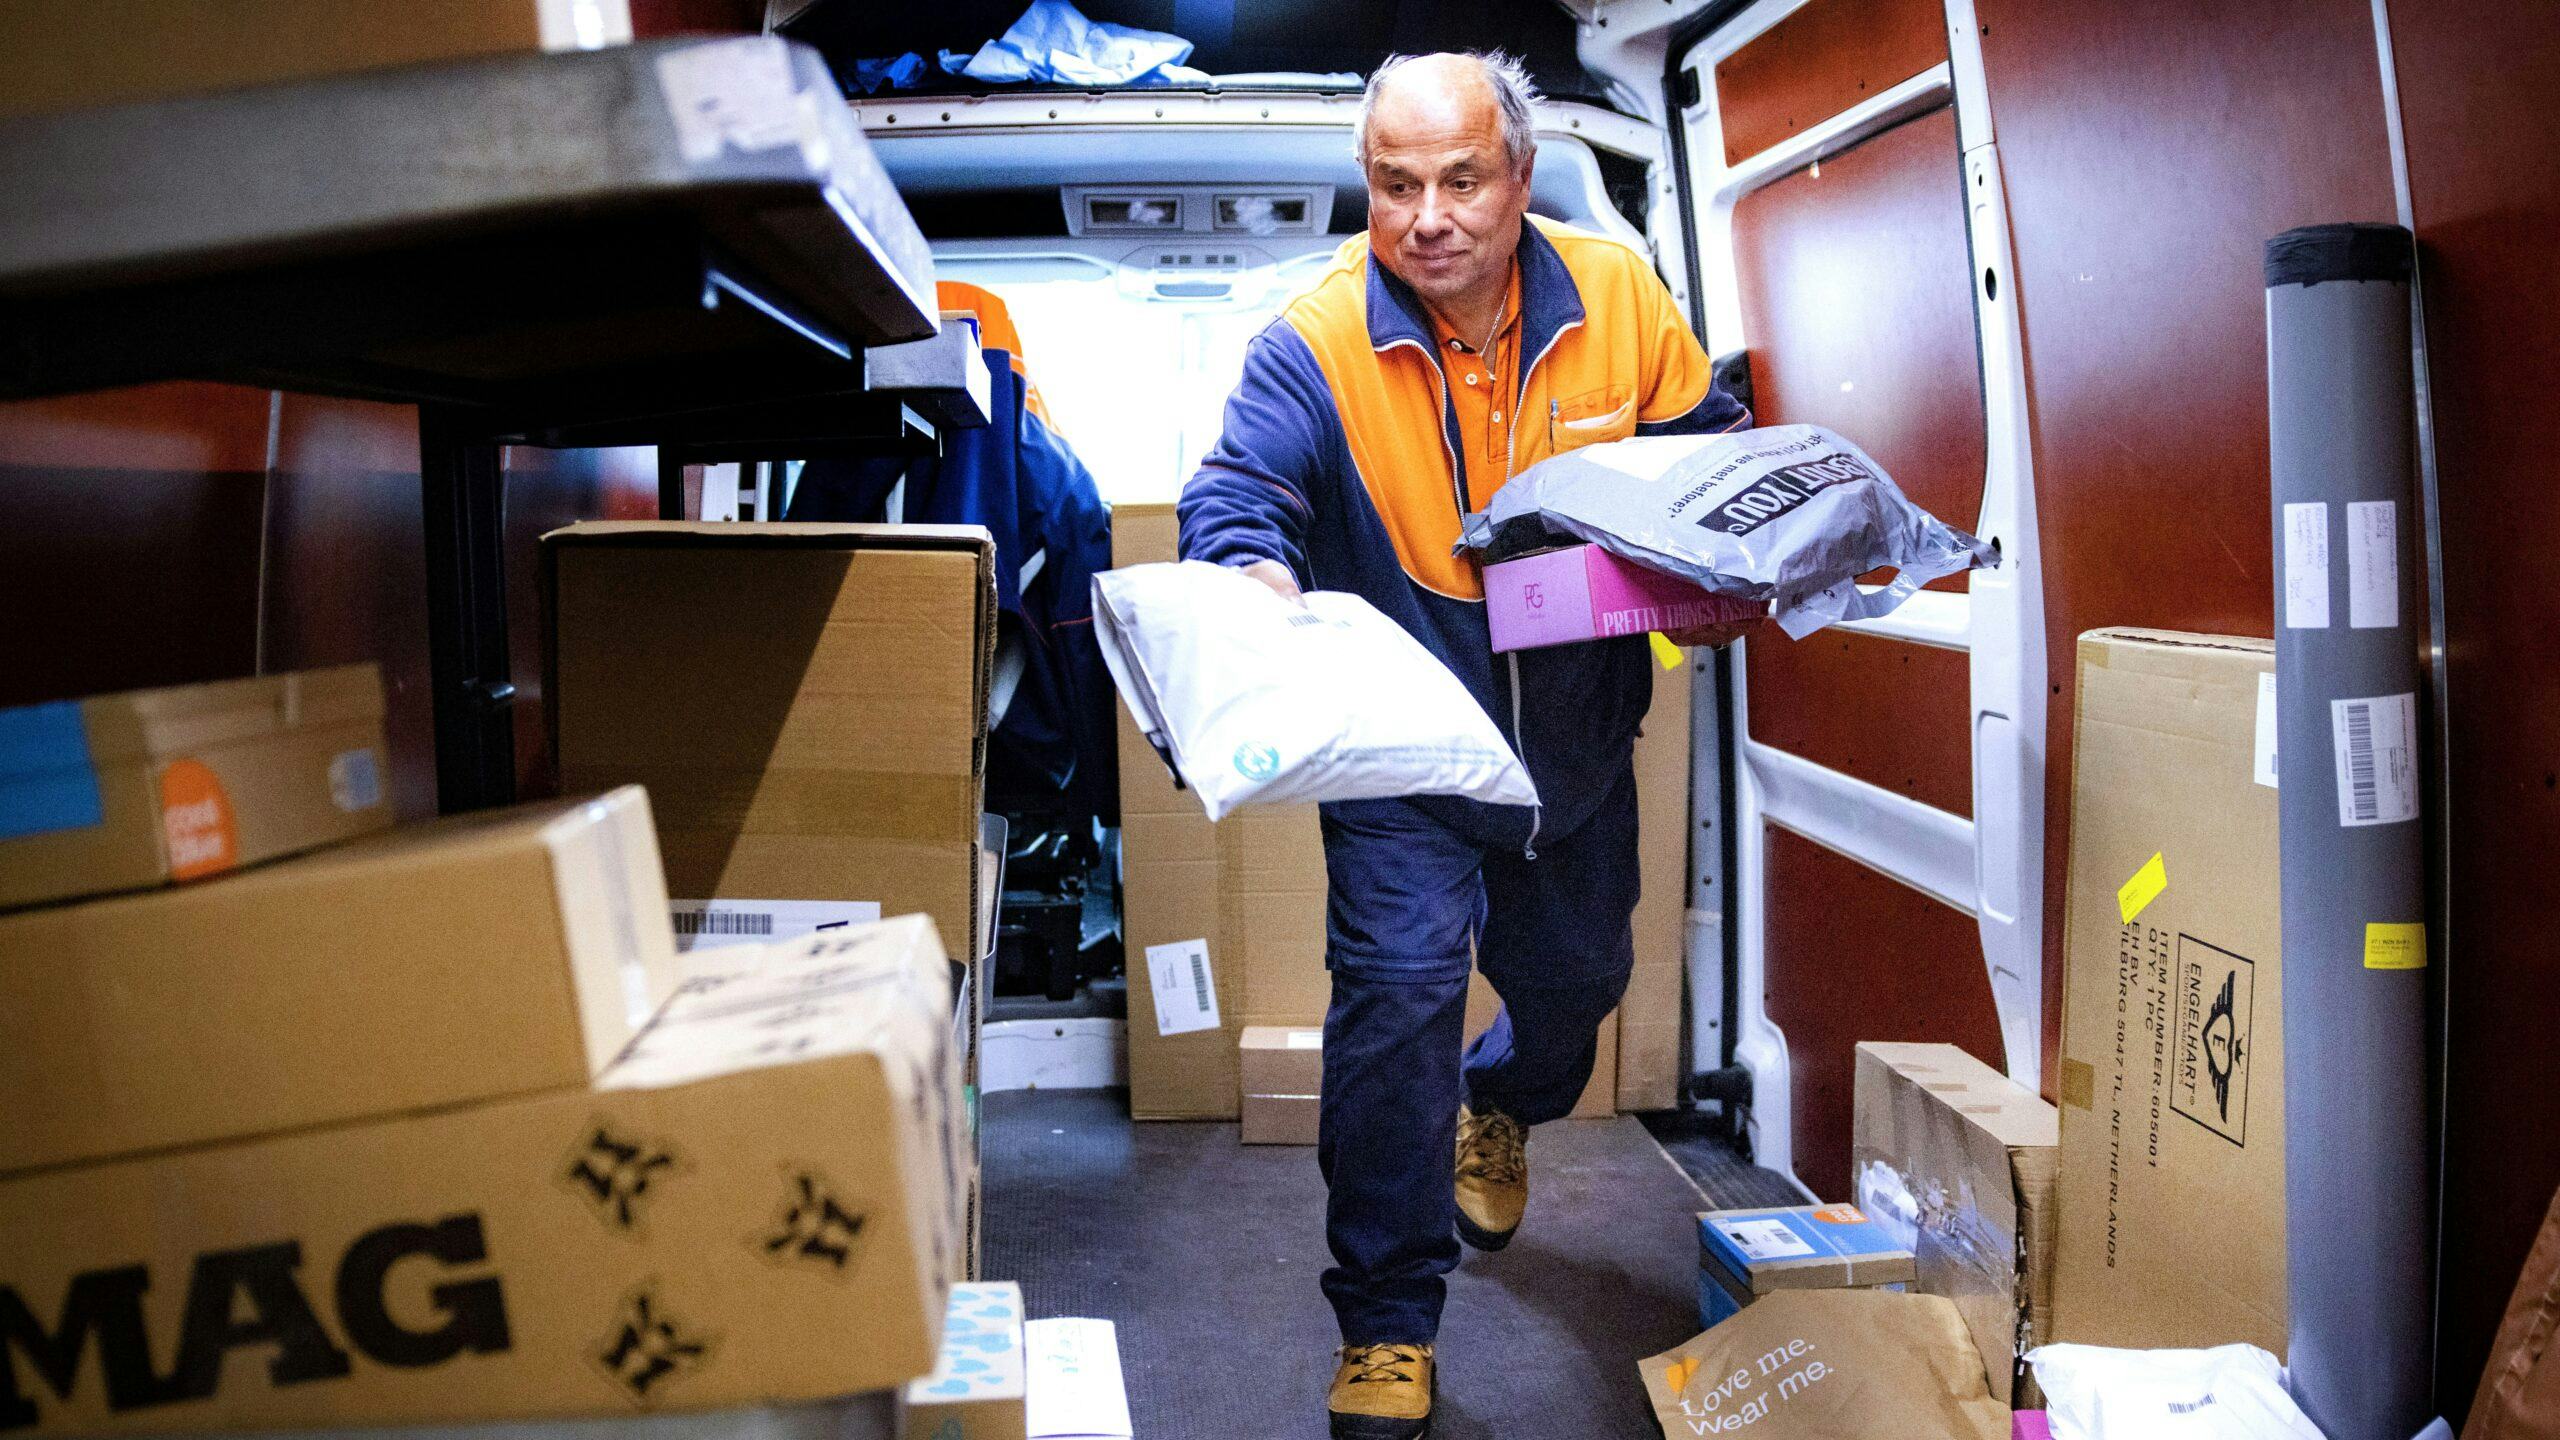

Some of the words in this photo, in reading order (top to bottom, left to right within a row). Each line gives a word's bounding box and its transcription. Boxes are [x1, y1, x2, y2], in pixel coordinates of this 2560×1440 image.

[1711, 464, 1738, 483] met
[1602, 606, 1659, 637] PRETTY
[2130, 921, 2140, 950] EH
[2148, 927, 2158, 977] QTY:
[2157, 931, 2168, 984] ITEM
[2129, 957, 2139, 986] BV
[2145, 1001, 2155, 1031] PC
[2116, 1020, 2126, 1067] 5047
[2106, 1109, 2121, 1269] NETHERLANDS
[1679, 1368, 1752, 1417] Love
[1757, 1338, 1816, 1377] me.
[1686, 1391, 1769, 1436] Wear
[1777, 1360, 1835, 1401] me.
